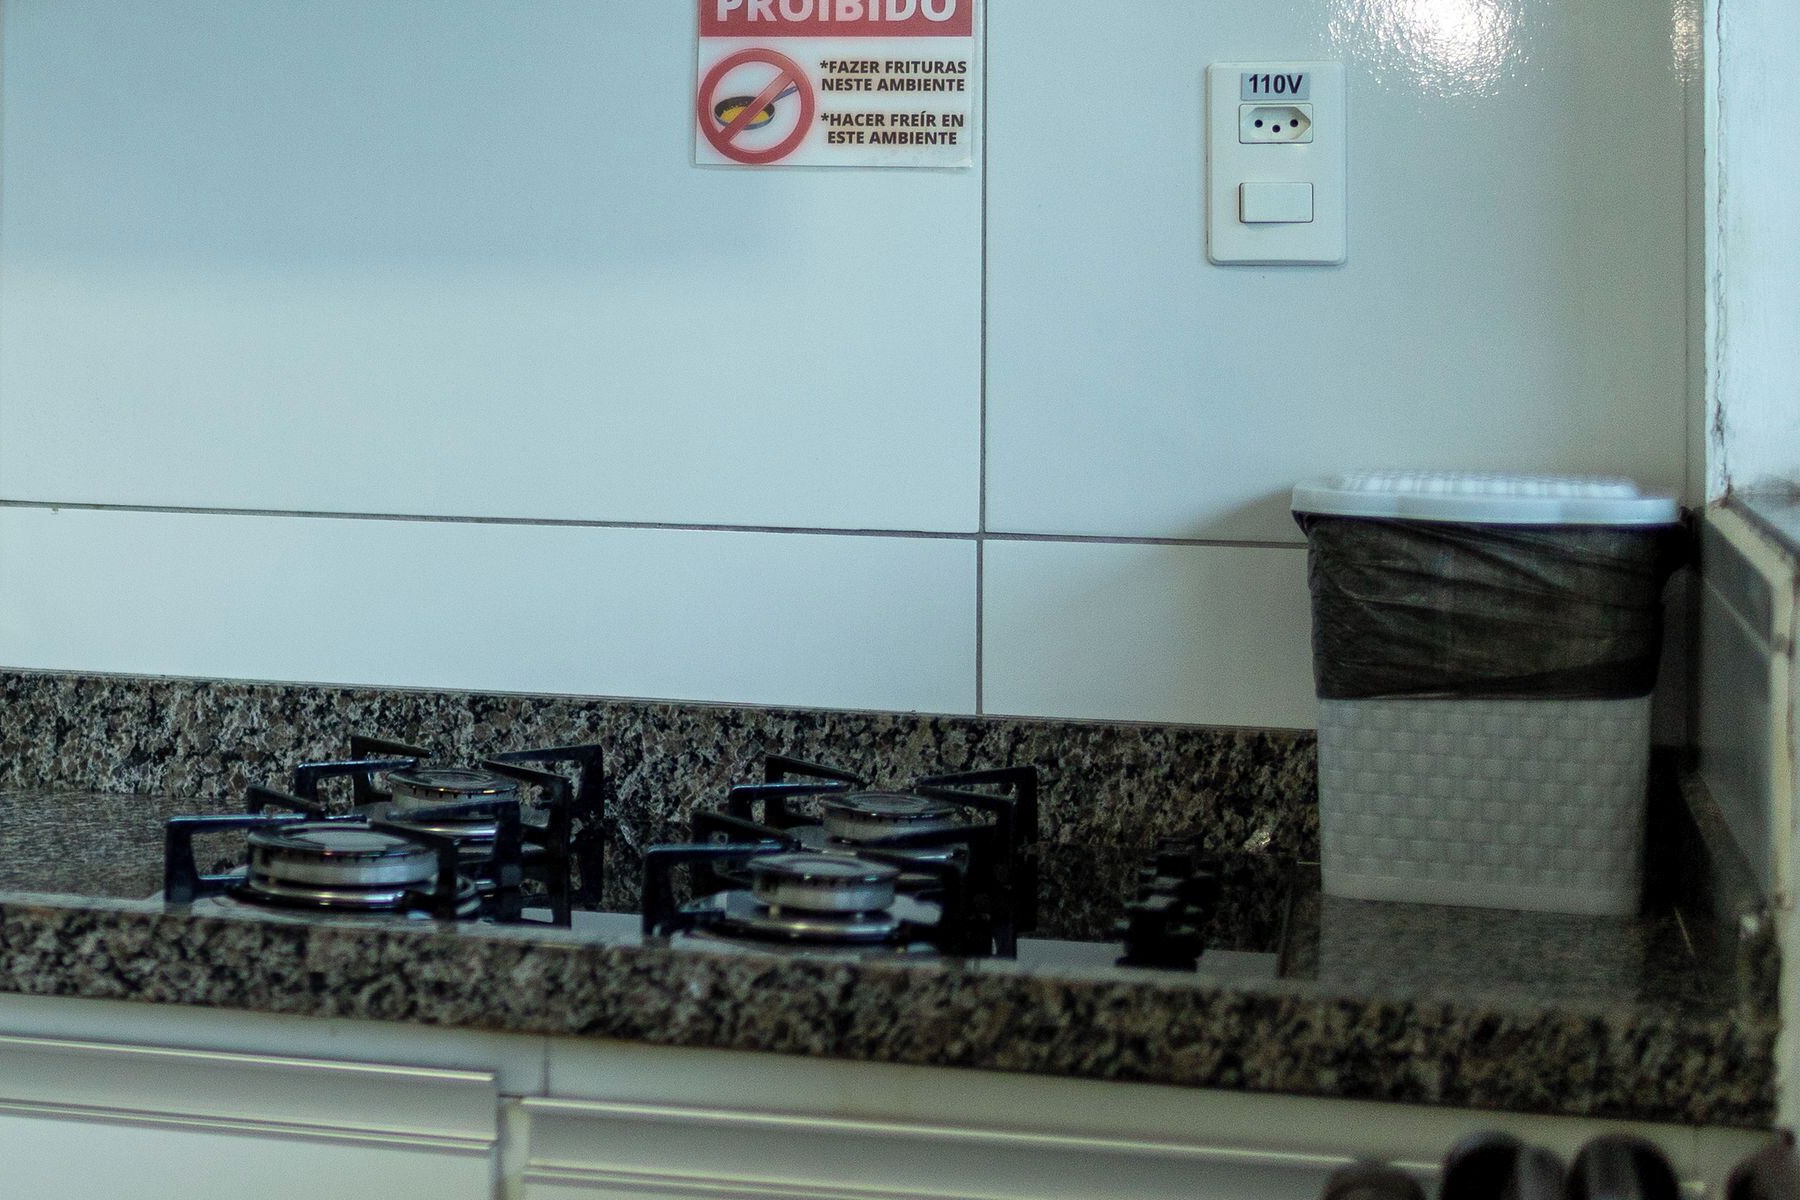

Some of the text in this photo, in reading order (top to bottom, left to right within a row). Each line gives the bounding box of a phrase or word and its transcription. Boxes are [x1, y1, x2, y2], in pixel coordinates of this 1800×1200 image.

[885, 60, 967, 74] FRITURAS
[821, 78, 965, 92] NESTE AMBIENTE
[1248, 74, 1303, 94] 110V
[890, 110, 936, 127] FREÍR
[941, 113, 964, 127] EN
[827, 131, 957, 145] ESTE AMBIENTE
